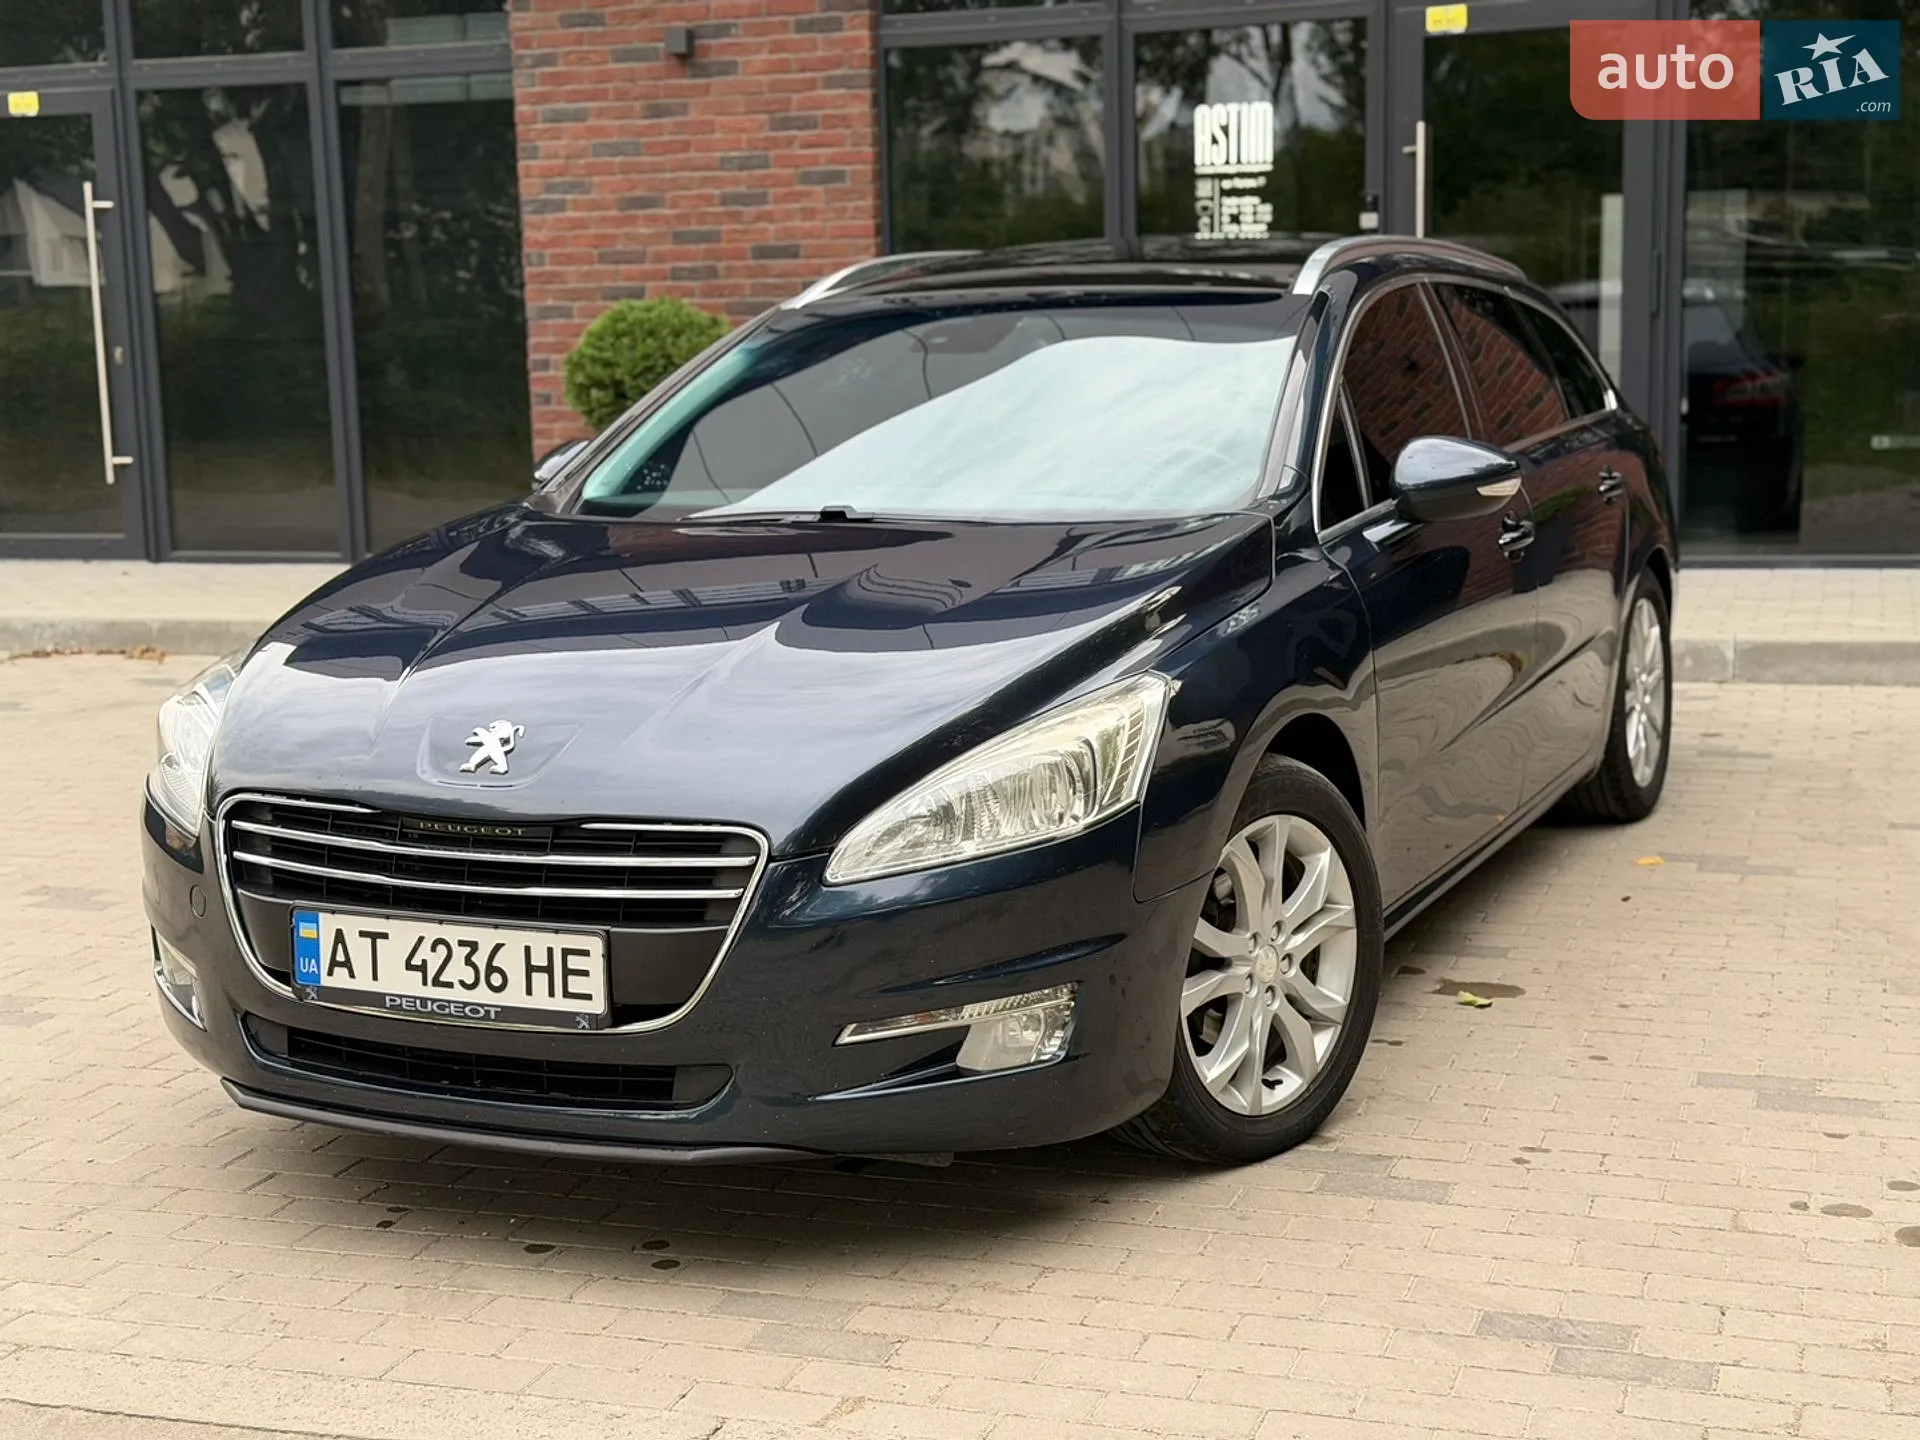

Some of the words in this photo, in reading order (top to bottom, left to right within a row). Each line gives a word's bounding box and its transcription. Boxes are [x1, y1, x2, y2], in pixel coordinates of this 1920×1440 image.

[419, 821, 527, 836] PEUGEOT
[300, 957, 319, 975] UA
[326, 927, 390, 981] AT
[404, 934, 509, 994] 4236
[523, 944, 593, 1001] HE
[385, 994, 502, 1020] PEUGEOT
